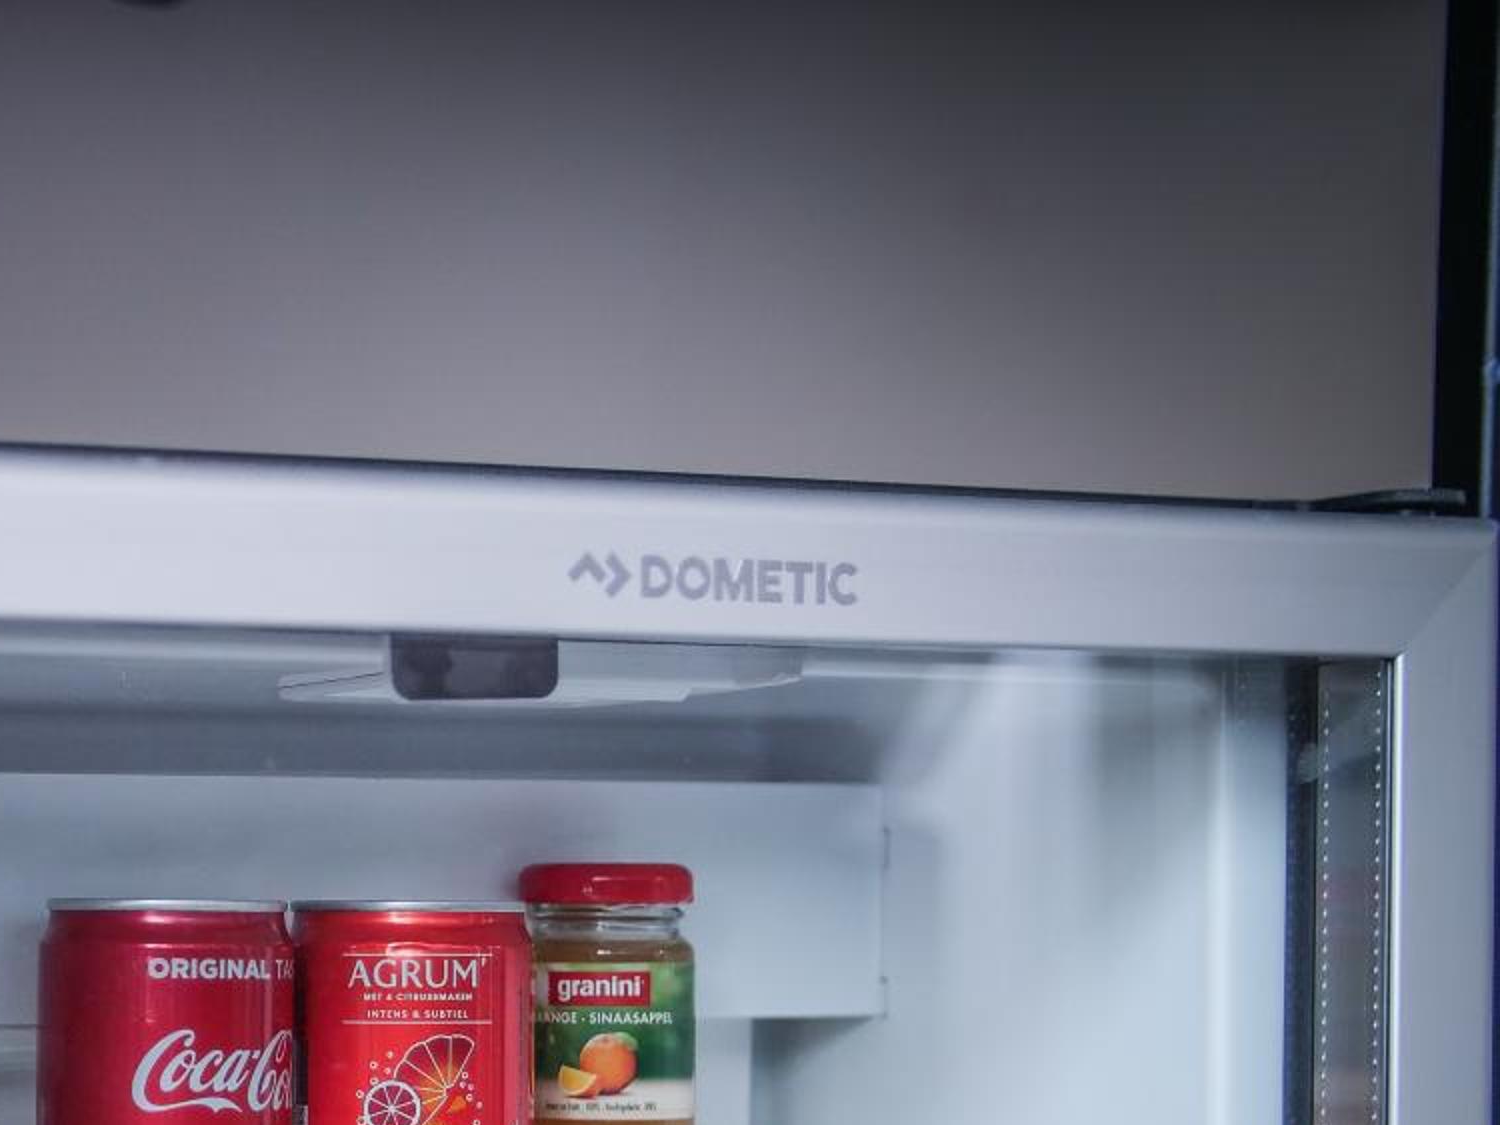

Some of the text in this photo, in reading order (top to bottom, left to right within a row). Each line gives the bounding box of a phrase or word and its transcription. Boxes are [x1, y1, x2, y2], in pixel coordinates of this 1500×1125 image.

[640, 554, 857, 606] DOMETIC
[147, 957, 271, 980] ORIGINAL
[557, 975, 641, 1003] granini
[367, 1008, 408, 1019] INTENS
[424, 1008, 469, 1019] SUBTIEL
[589, 1011, 673, 1025] SINAASAPPEL
